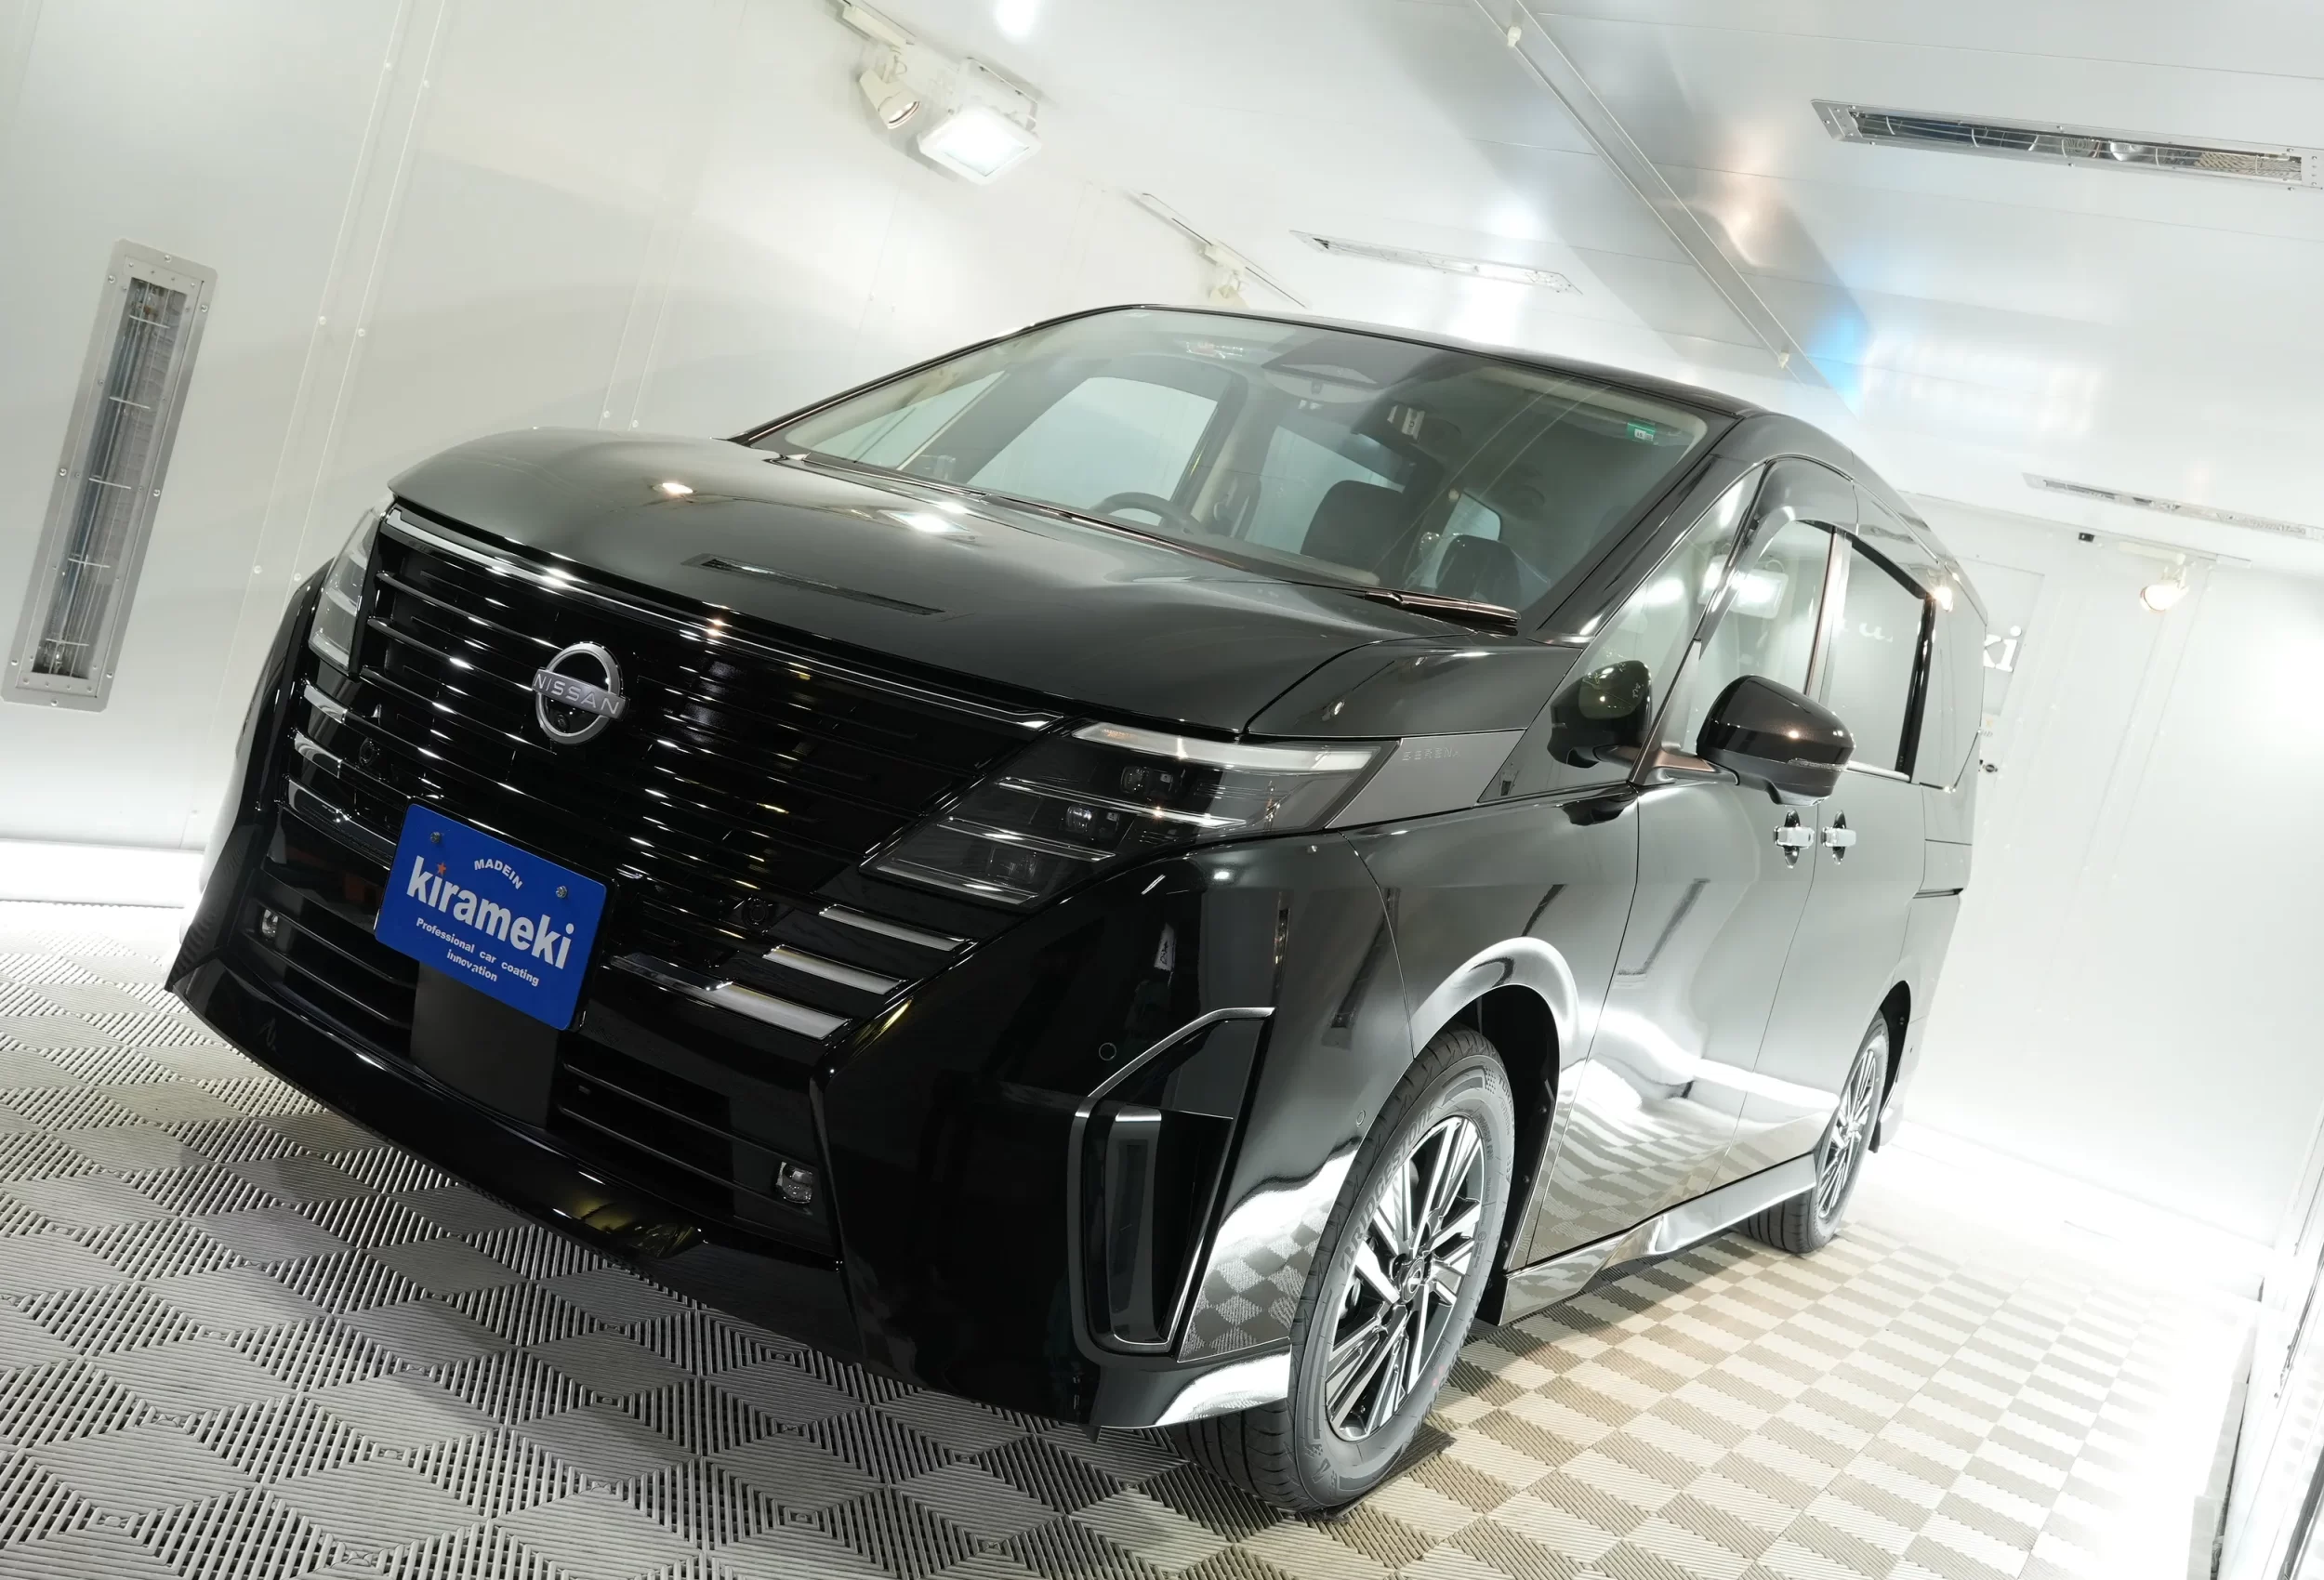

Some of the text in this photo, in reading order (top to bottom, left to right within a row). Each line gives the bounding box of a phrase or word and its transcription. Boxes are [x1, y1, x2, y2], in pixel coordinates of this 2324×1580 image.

[533, 674, 619, 715] NISSAN
[1402, 747, 1460, 762] SERENA
[474, 859, 523, 889] MADEIN
[406, 855, 574, 969] kirameki
[416, 917, 540, 987] Professional car coating
[446, 949, 497, 981] innovation
[1340, 1098, 1435, 1273] BRIDGESTONE
